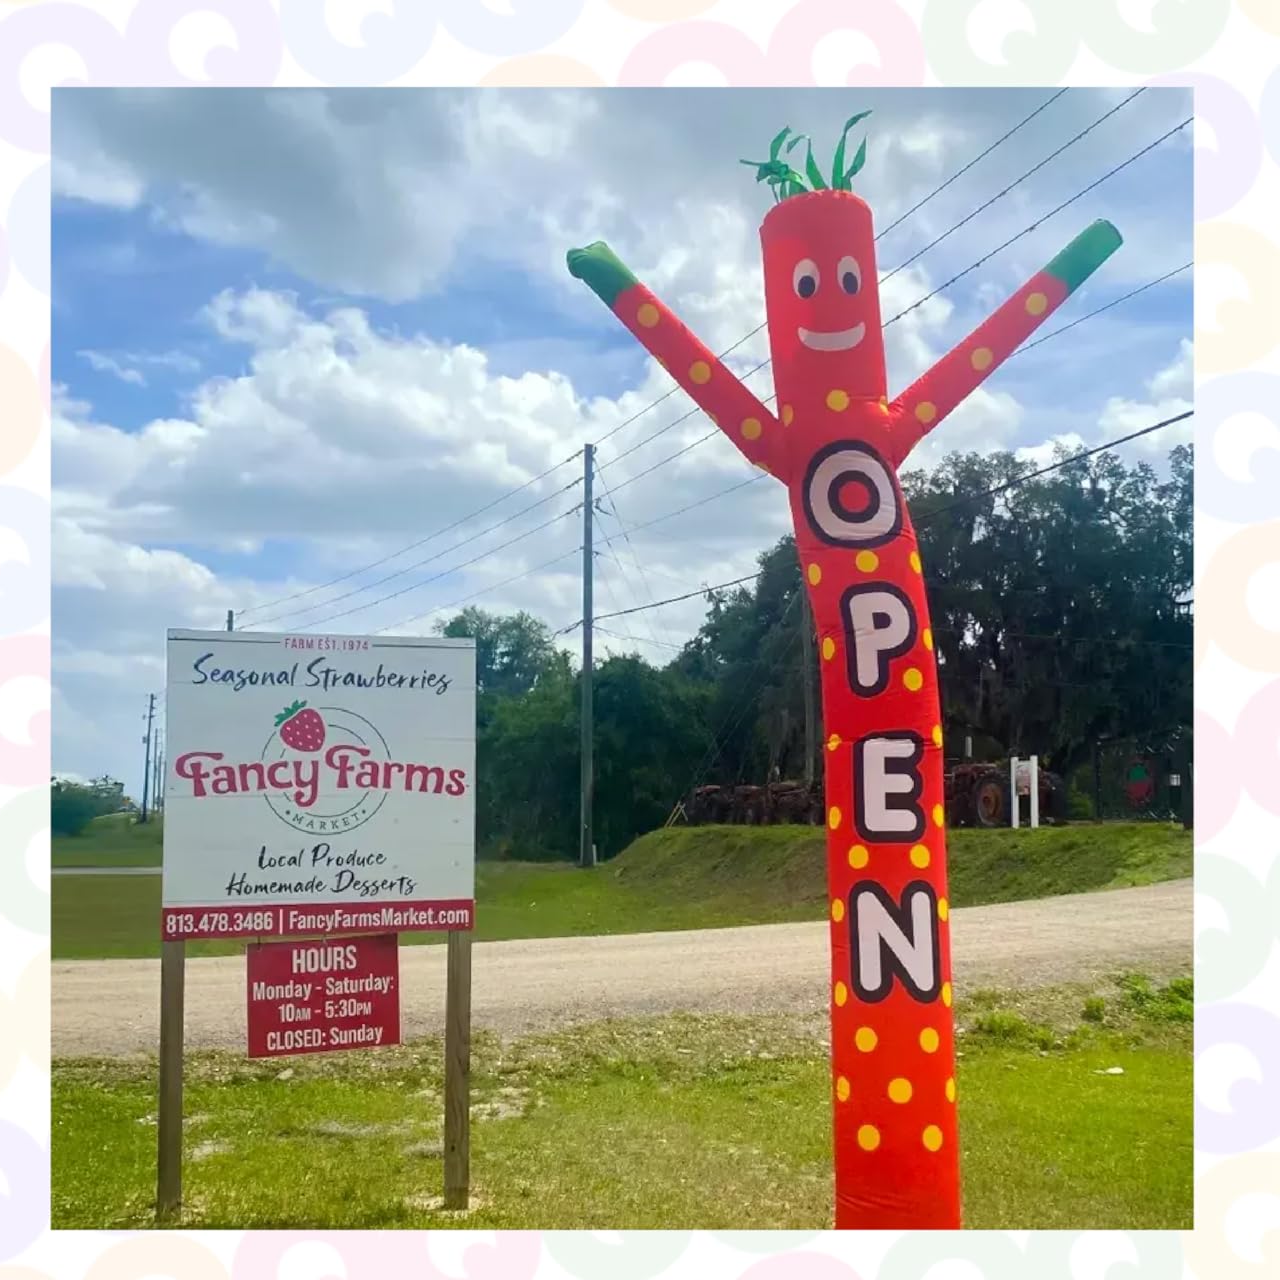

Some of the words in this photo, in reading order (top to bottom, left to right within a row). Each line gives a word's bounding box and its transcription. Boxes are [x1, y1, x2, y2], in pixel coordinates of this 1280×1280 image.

[284, 638, 314, 650] FARM
[193, 653, 297, 691] Seasonal
[305, 657, 452, 695] Strawberries
[804, 442, 939, 1001] OPEN
[175, 752, 320, 807] Fancy
[325, 745, 466, 796] Farms
[292, 811, 360, 830] MARKET
[258, 846, 303, 868] Local
[312, 843, 387, 868] Produce
[226, 872, 326, 896] Homemade
[330, 870, 418, 896] Desserts
[167, 912, 273, 934] 813.478.3486
[289, 908, 469, 931] FancyFarmsMarket.com
[292, 945, 357, 973] HOURS
[253, 981, 311, 1000] Monday
[326, 975, 394, 996] Saturday:
[267, 1029, 326, 1050] CLOSED:
[330, 1025, 383, 1046] Sunday
